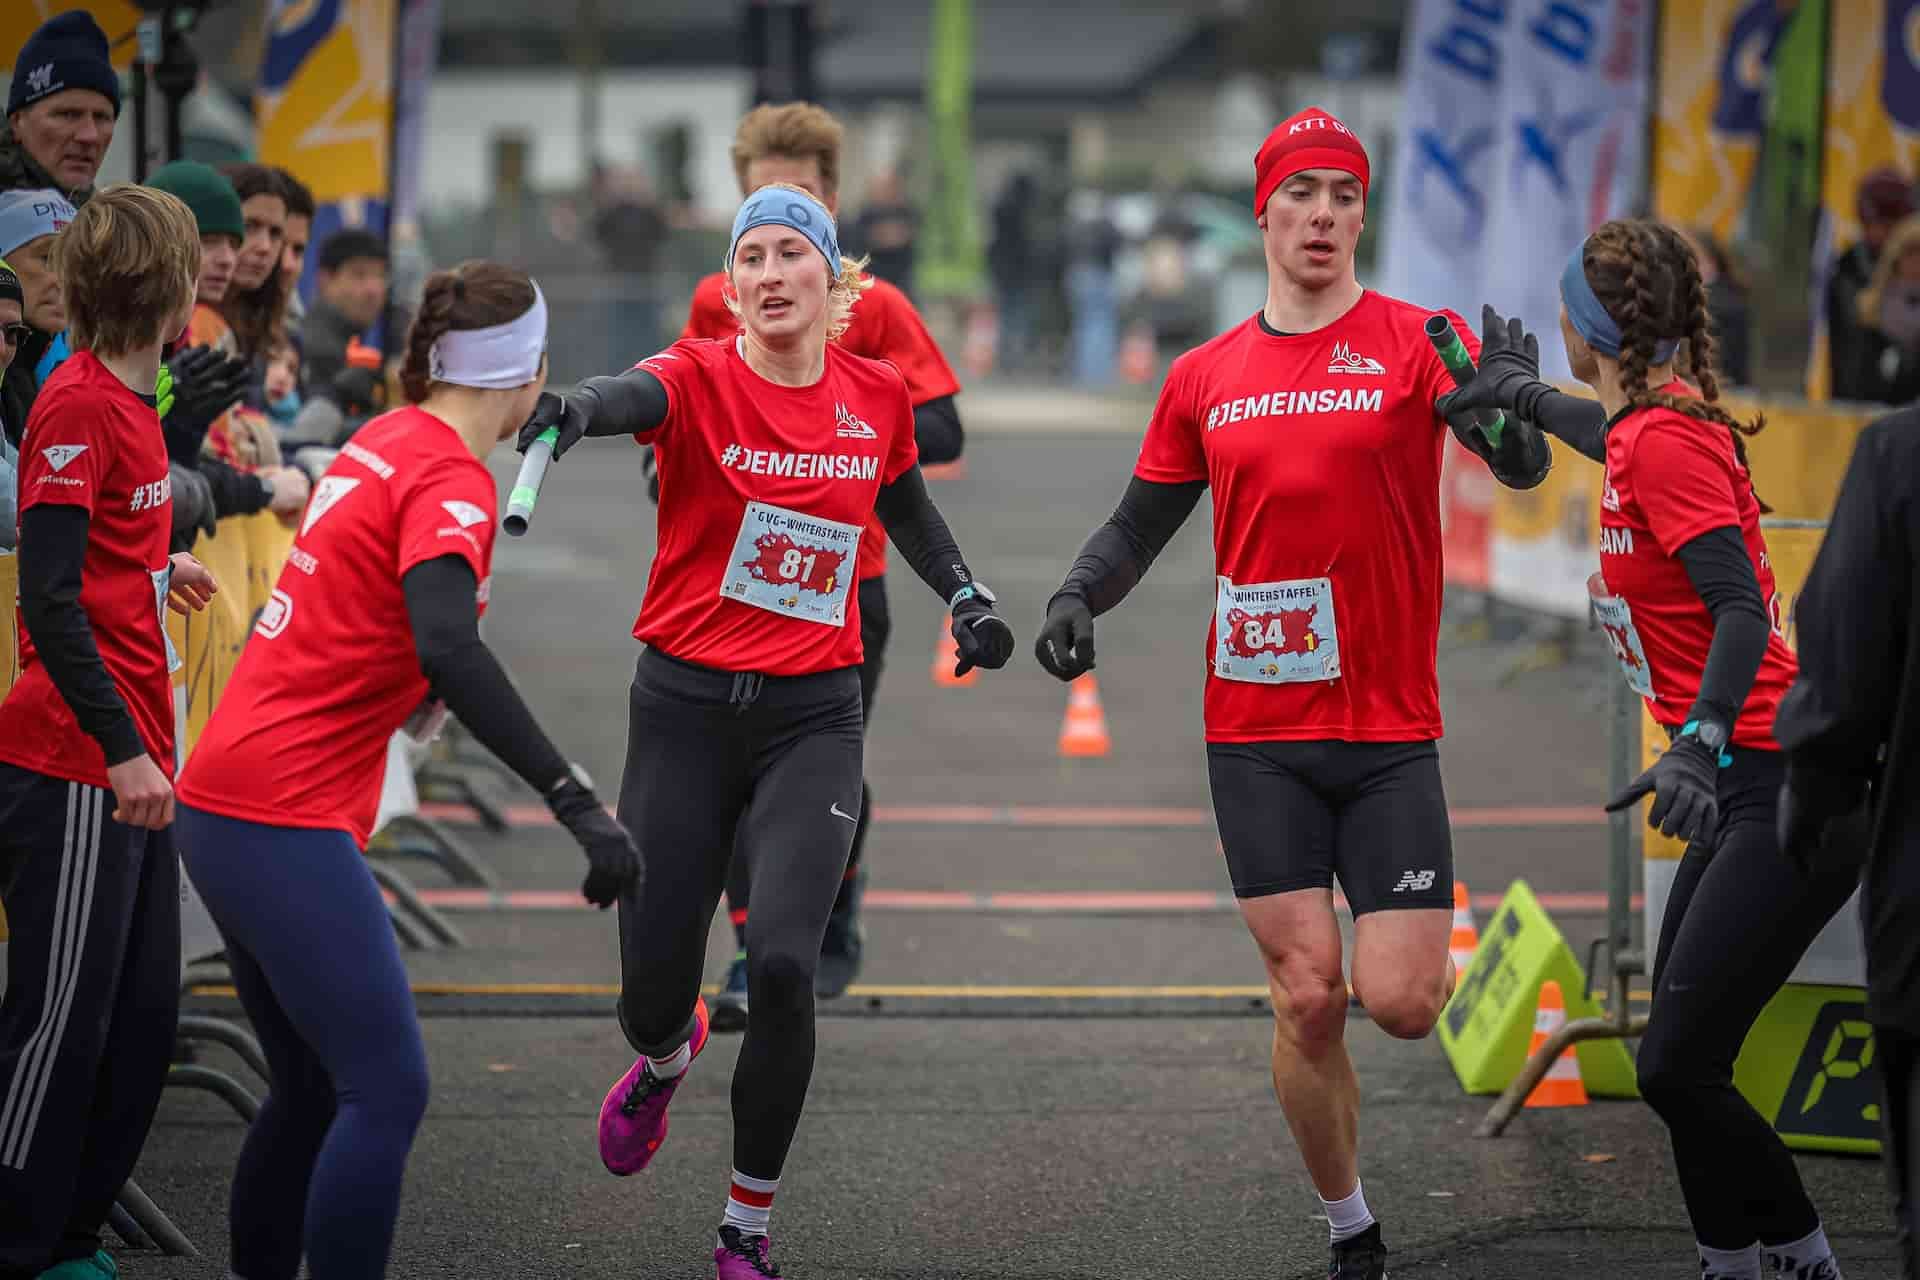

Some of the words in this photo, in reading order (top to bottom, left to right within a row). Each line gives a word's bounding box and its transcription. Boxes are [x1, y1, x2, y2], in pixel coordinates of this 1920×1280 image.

[1289, 118, 1326, 135] KTT
[1207, 389, 1383, 432] #JEMEINSAM
[721, 443, 879, 480] #JEMEINSAM
[778, 548, 816, 582] 81
[1244, 618, 1286, 649] 84
[1304, 632, 1314, 650] 1
